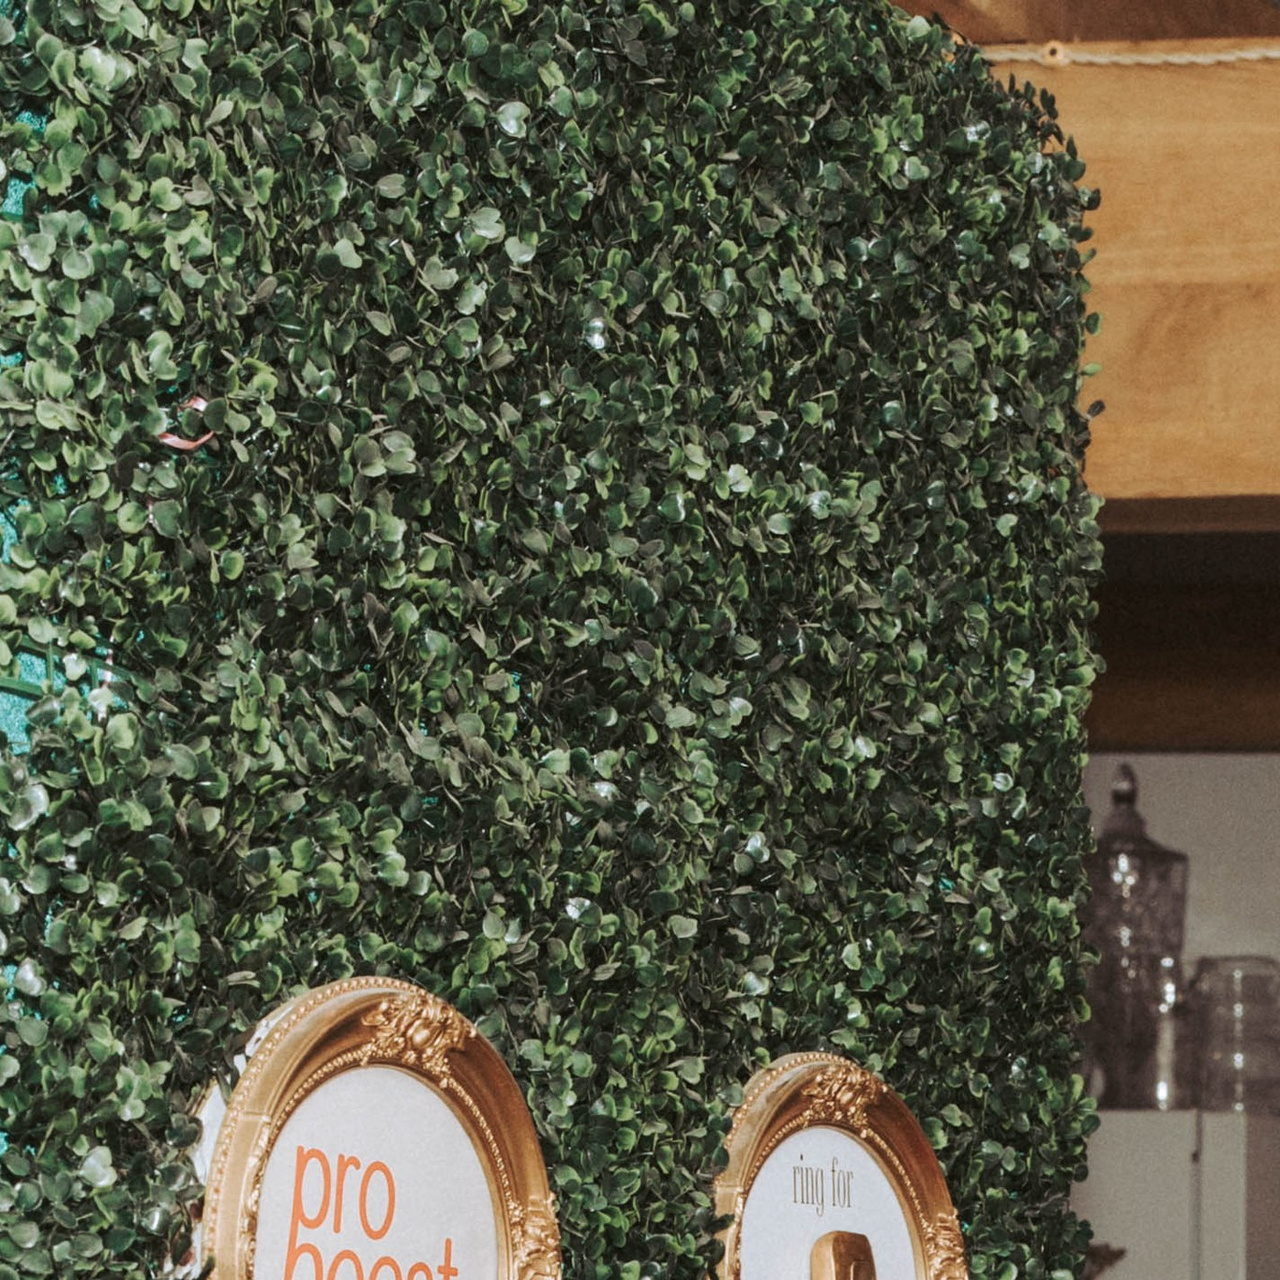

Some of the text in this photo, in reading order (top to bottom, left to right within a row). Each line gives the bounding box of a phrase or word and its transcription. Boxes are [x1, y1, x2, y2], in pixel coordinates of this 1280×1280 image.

[290, 1145, 396, 1240] pro
[792, 1153, 854, 1217] ring for
